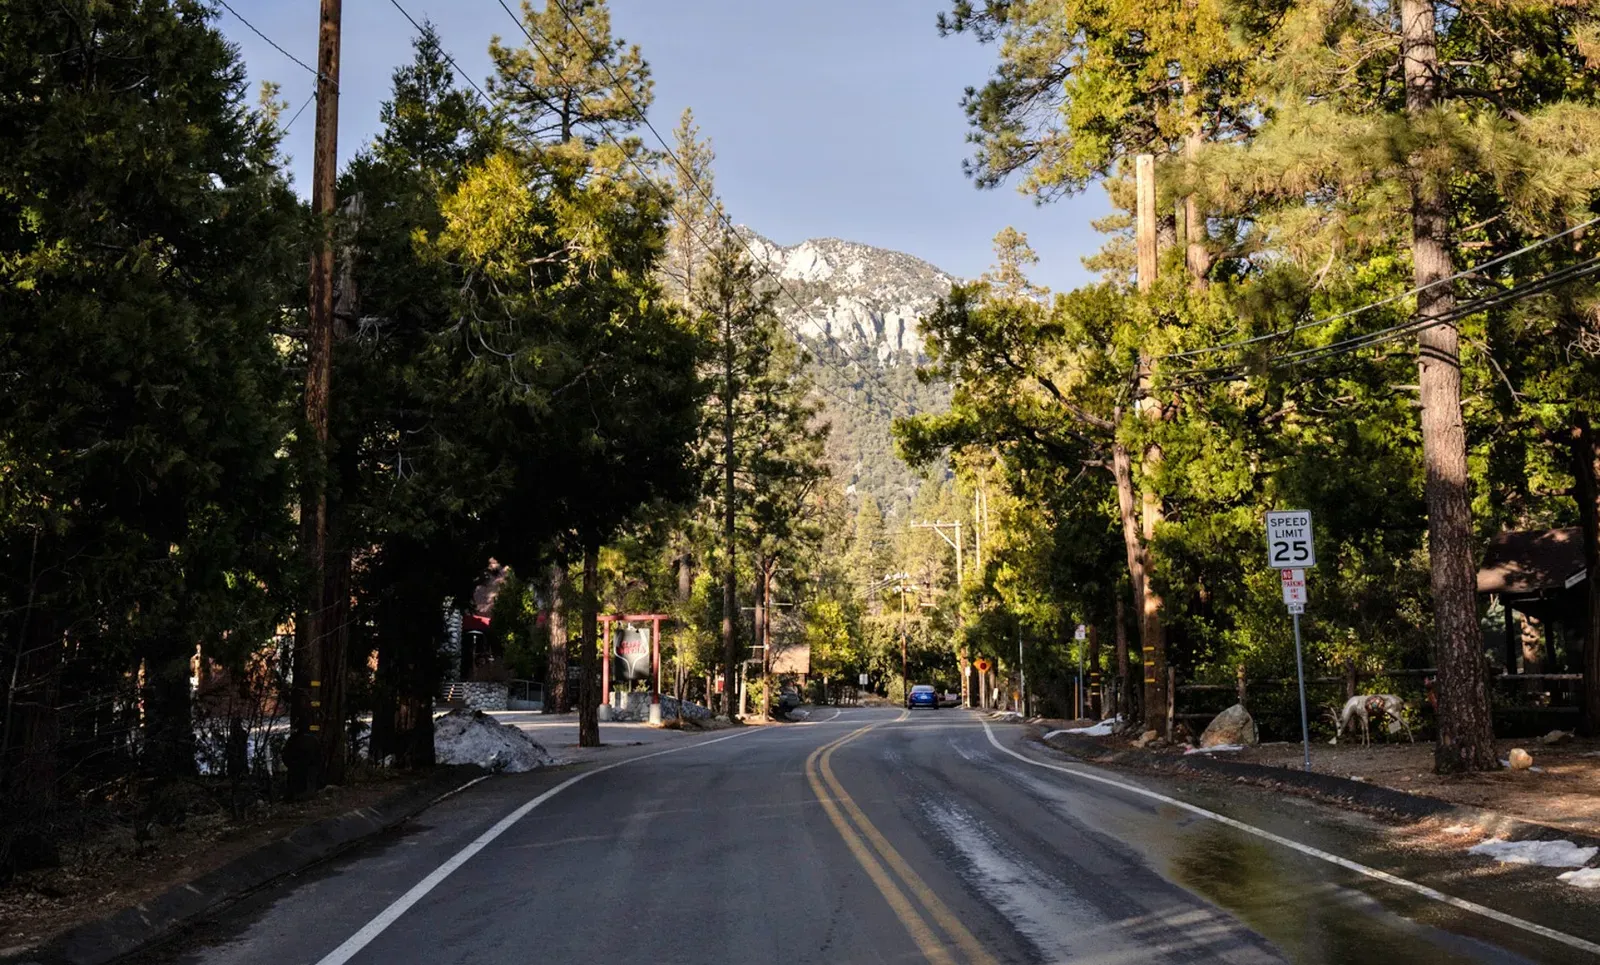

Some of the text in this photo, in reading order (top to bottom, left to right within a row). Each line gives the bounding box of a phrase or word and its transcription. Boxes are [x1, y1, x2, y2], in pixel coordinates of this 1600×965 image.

[1270, 517, 1307, 527] SPEED
[1275, 529, 1304, 538] LIMIT
[1273, 541, 1309, 561] 25
[1283, 570, 1292, 580] NO
